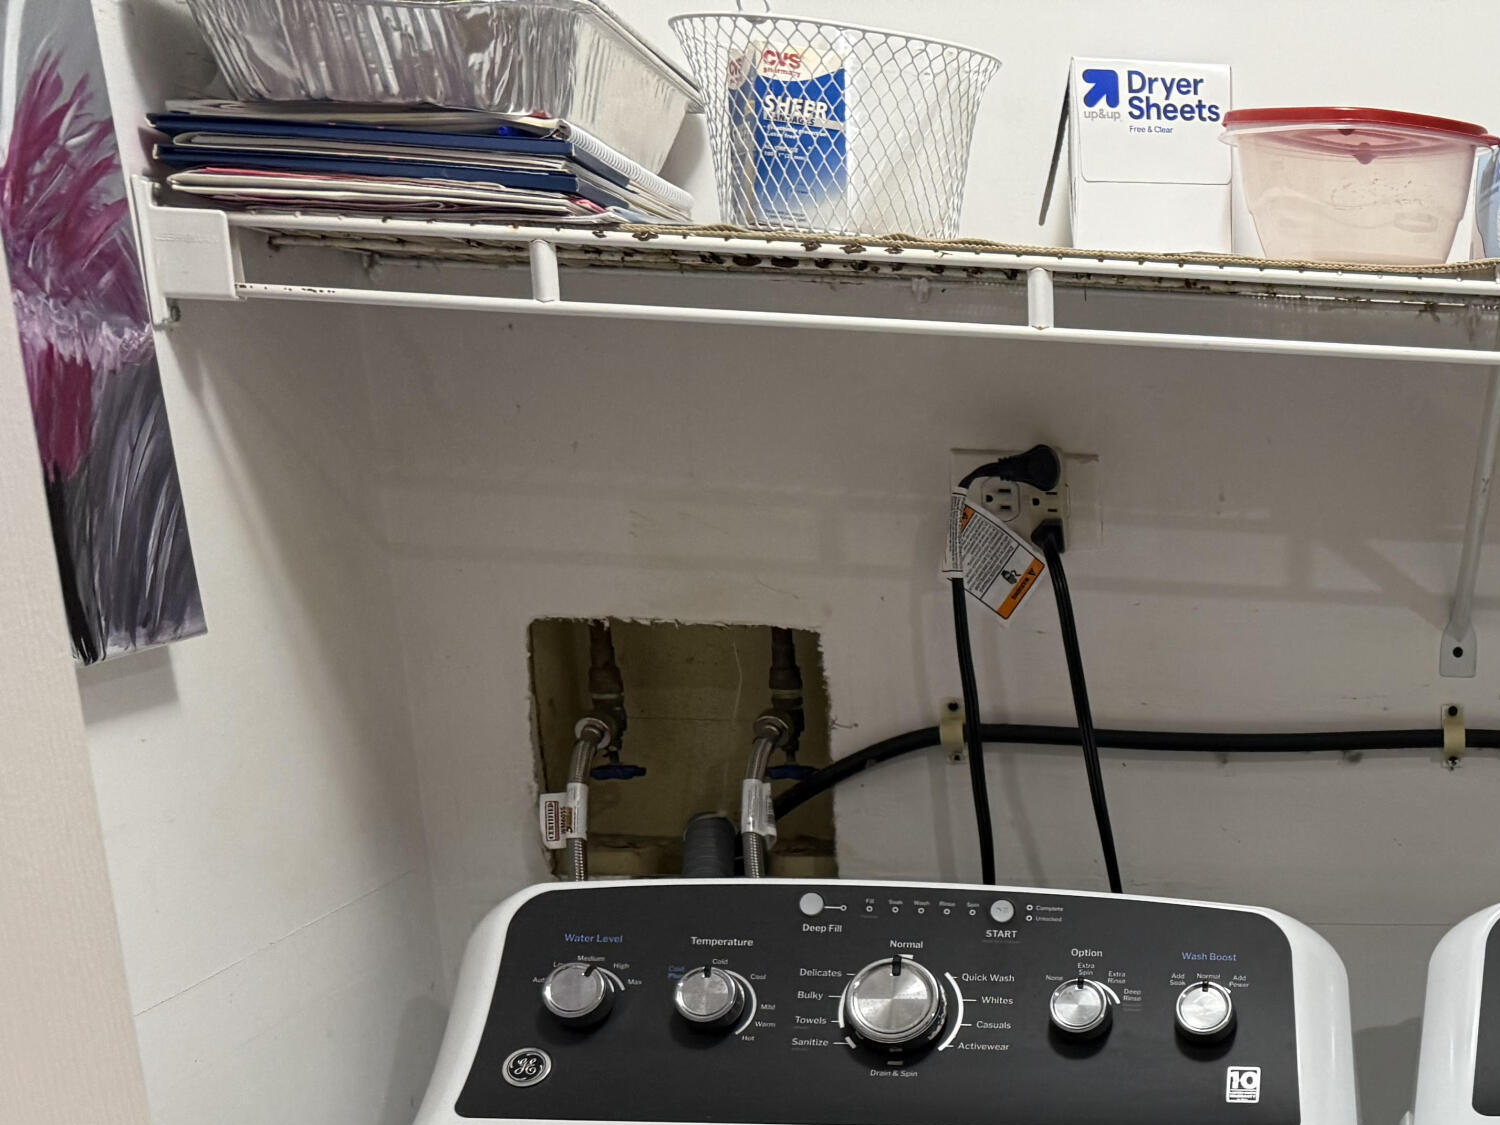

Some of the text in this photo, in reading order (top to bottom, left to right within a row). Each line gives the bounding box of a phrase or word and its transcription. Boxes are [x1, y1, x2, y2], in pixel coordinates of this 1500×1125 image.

[763, 50, 801, 69] CVS
[1127, 70, 1204, 100] Dryer
[763, 95, 828, 119] SHEER
[1128, 96, 1221, 122] Sheets
[1083, 109, 1121, 122] up&up
[1129, 125, 1146, 133] Free
[802, 923, 843, 933] Deep Fill
[564, 933, 624, 943] Water Level
[985, 929, 1018, 938] START
[691, 936, 754, 947] Temperature
[890, 939, 924, 949] Normal
[1070, 948, 1103, 958] Option
[1181, 951, 1237, 961] Wash Boost
[800, 968, 842, 977] Delicates
[961, 972, 1015, 982] Quick Wash
[797, 991, 824, 1000] Bulky
[981, 996, 1014, 1005] Whites
[795, 1015, 827, 1024] Towels
[976, 1020, 1012, 1030] Casuals
[791, 1038, 829, 1046] Sanitize
[958, 1042, 1009, 1051] Activewear
[870, 1069, 891, 1077] Drain
[1230, 1070, 1258, 1089] 10
